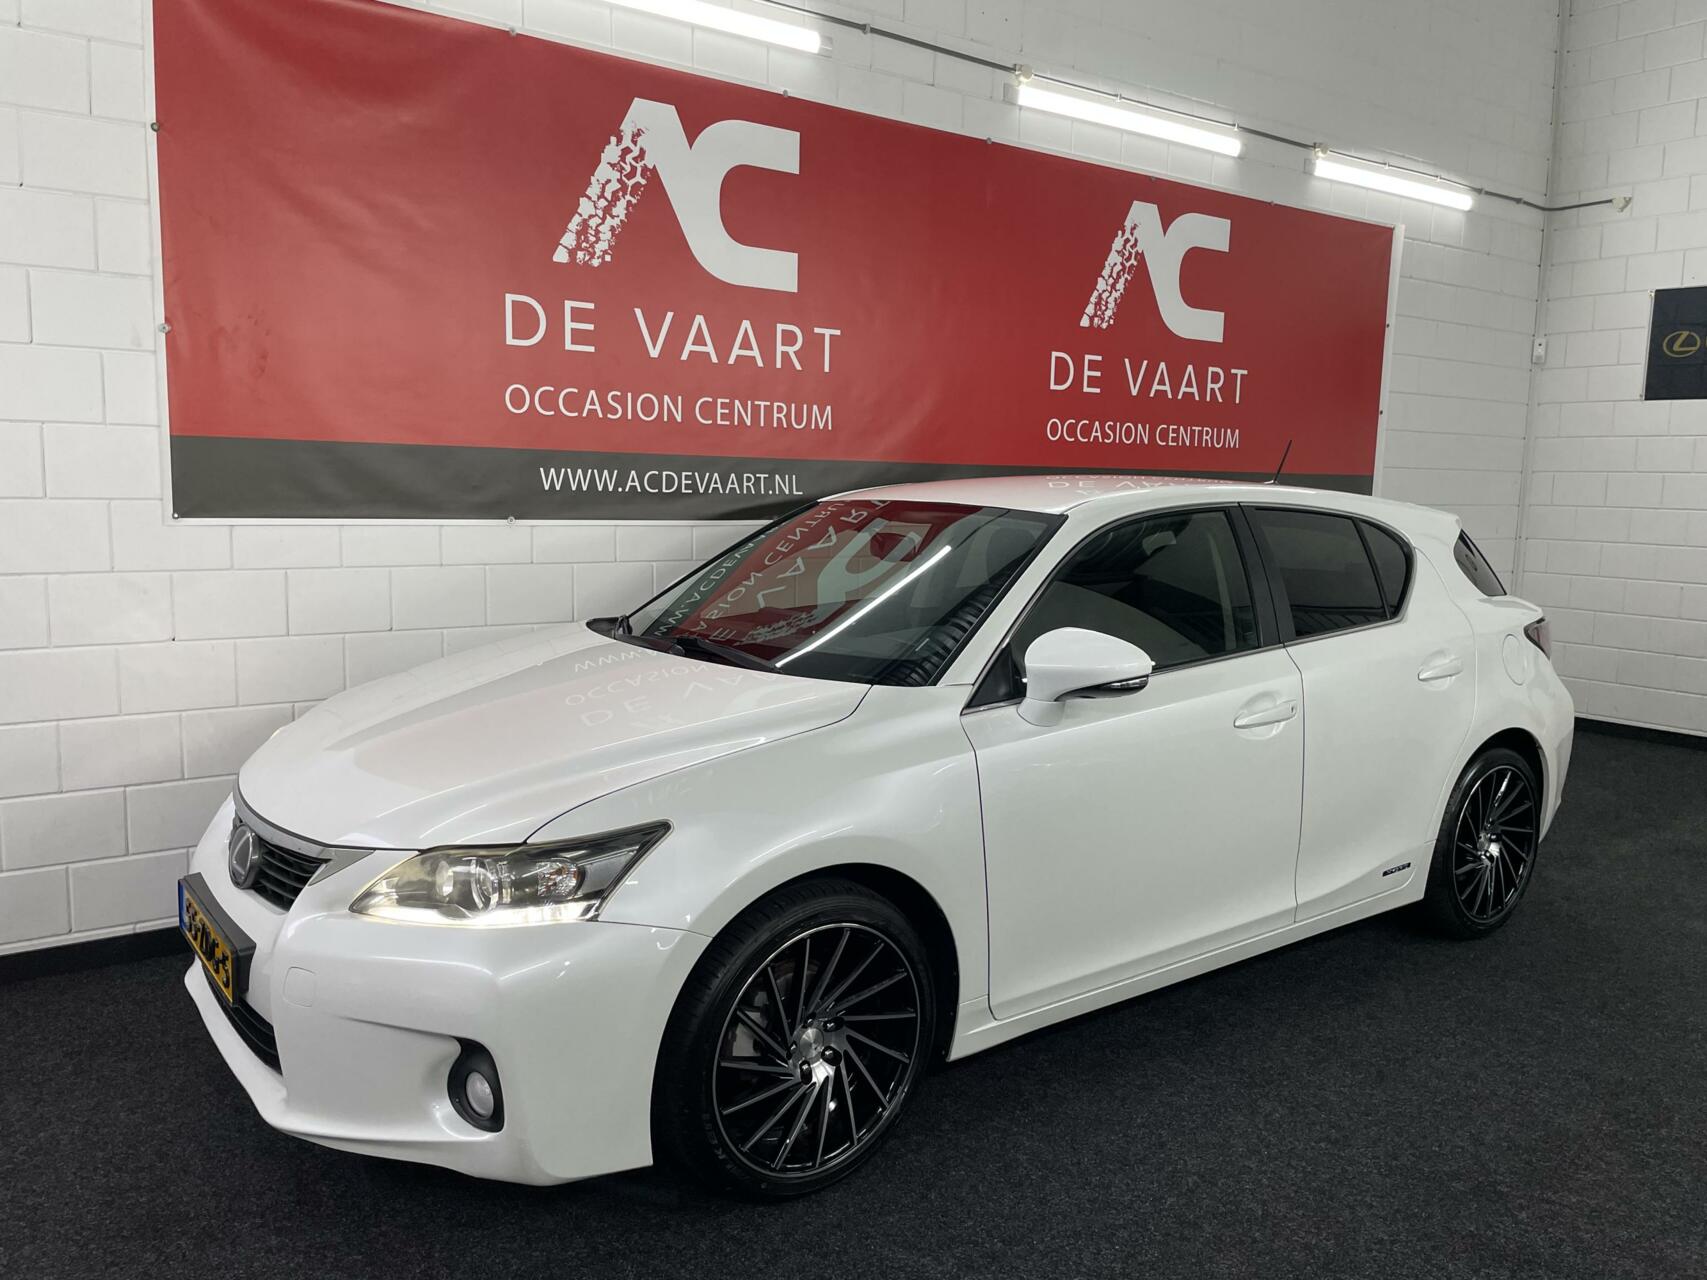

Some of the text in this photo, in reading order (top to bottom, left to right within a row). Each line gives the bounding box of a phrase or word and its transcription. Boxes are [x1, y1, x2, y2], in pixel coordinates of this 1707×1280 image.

[553, 97, 800, 292] AC
[505, 293, 841, 373] DE VAART
[1050, 351, 1248, 404] DE VAART
[505, 384, 833, 430] OCCASION CENTRUM
[1046, 418, 1240, 449] OCCASION CENTRUM
[540, 467, 804, 496] WWW.ACDEVAART.NL
